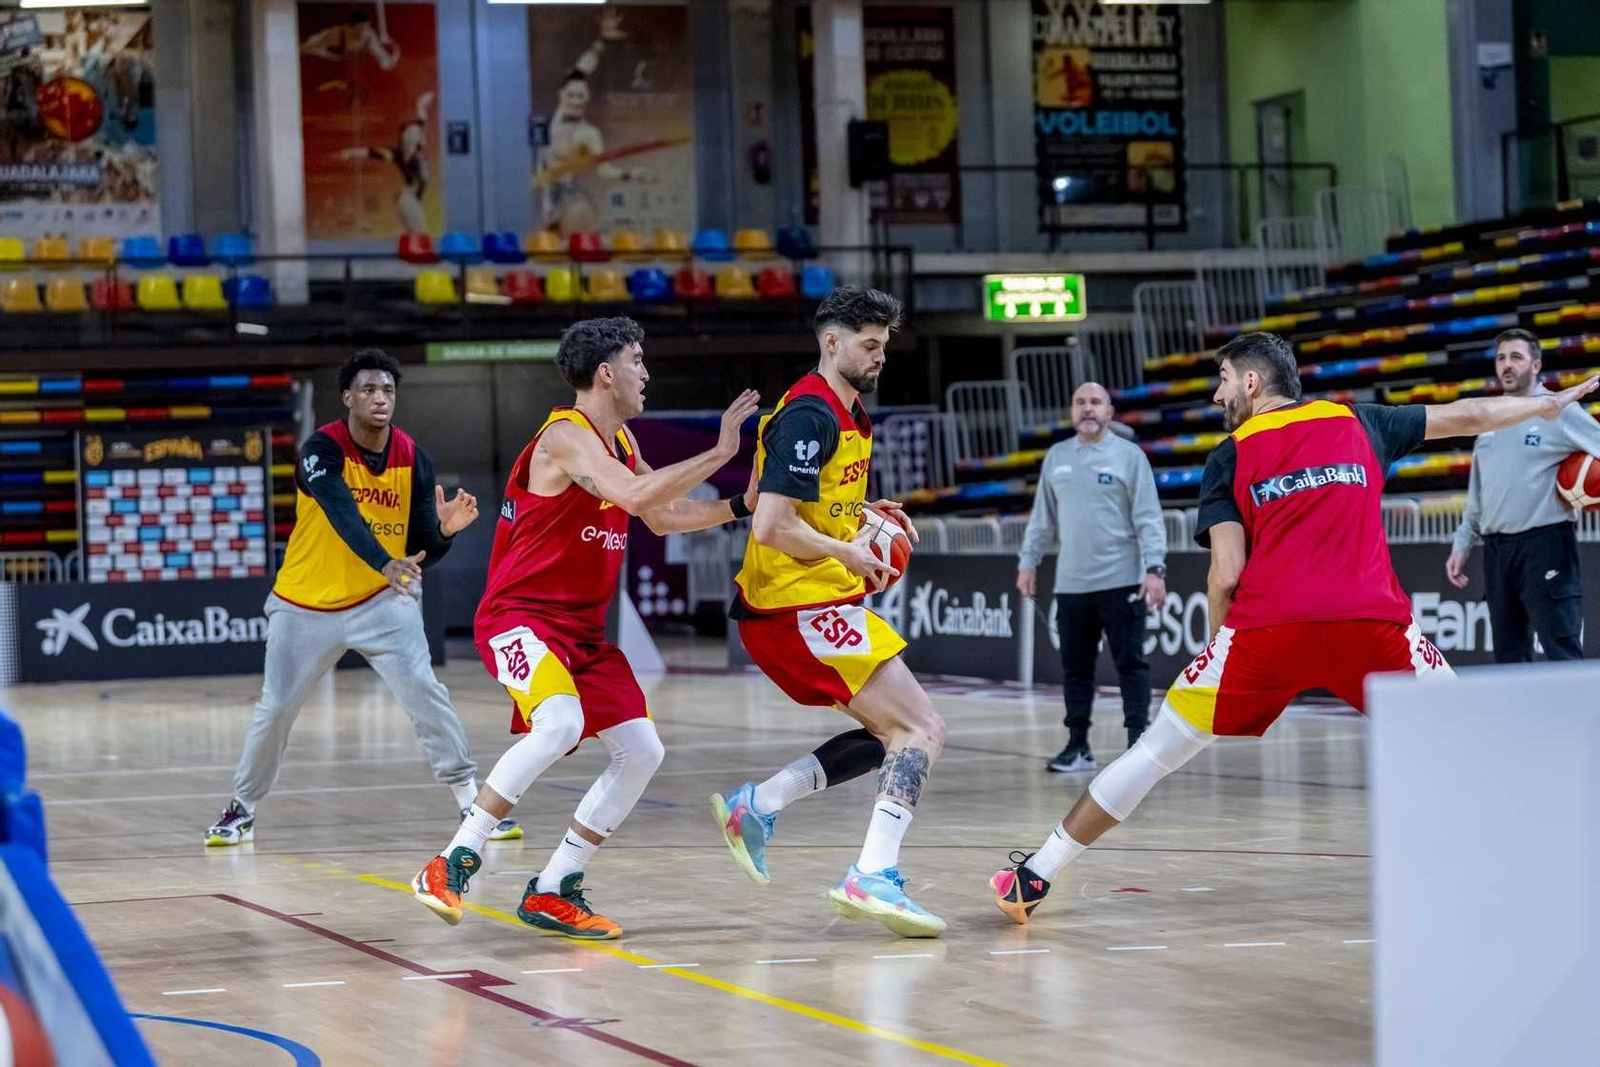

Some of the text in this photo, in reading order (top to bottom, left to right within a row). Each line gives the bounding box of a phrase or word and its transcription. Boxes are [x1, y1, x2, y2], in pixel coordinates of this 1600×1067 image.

[1037, 110, 1177, 136] VOLEIBOL
[0, 164, 99, 180] UADALAJARA
[1279, 464, 1363, 494] CaixaBank
[101, 605, 268, 648] CaixaBan
[810, 608, 863, 650] ESP
[932, 588, 1014, 638] CaixaBank
[499, 637, 531, 681] ESP
